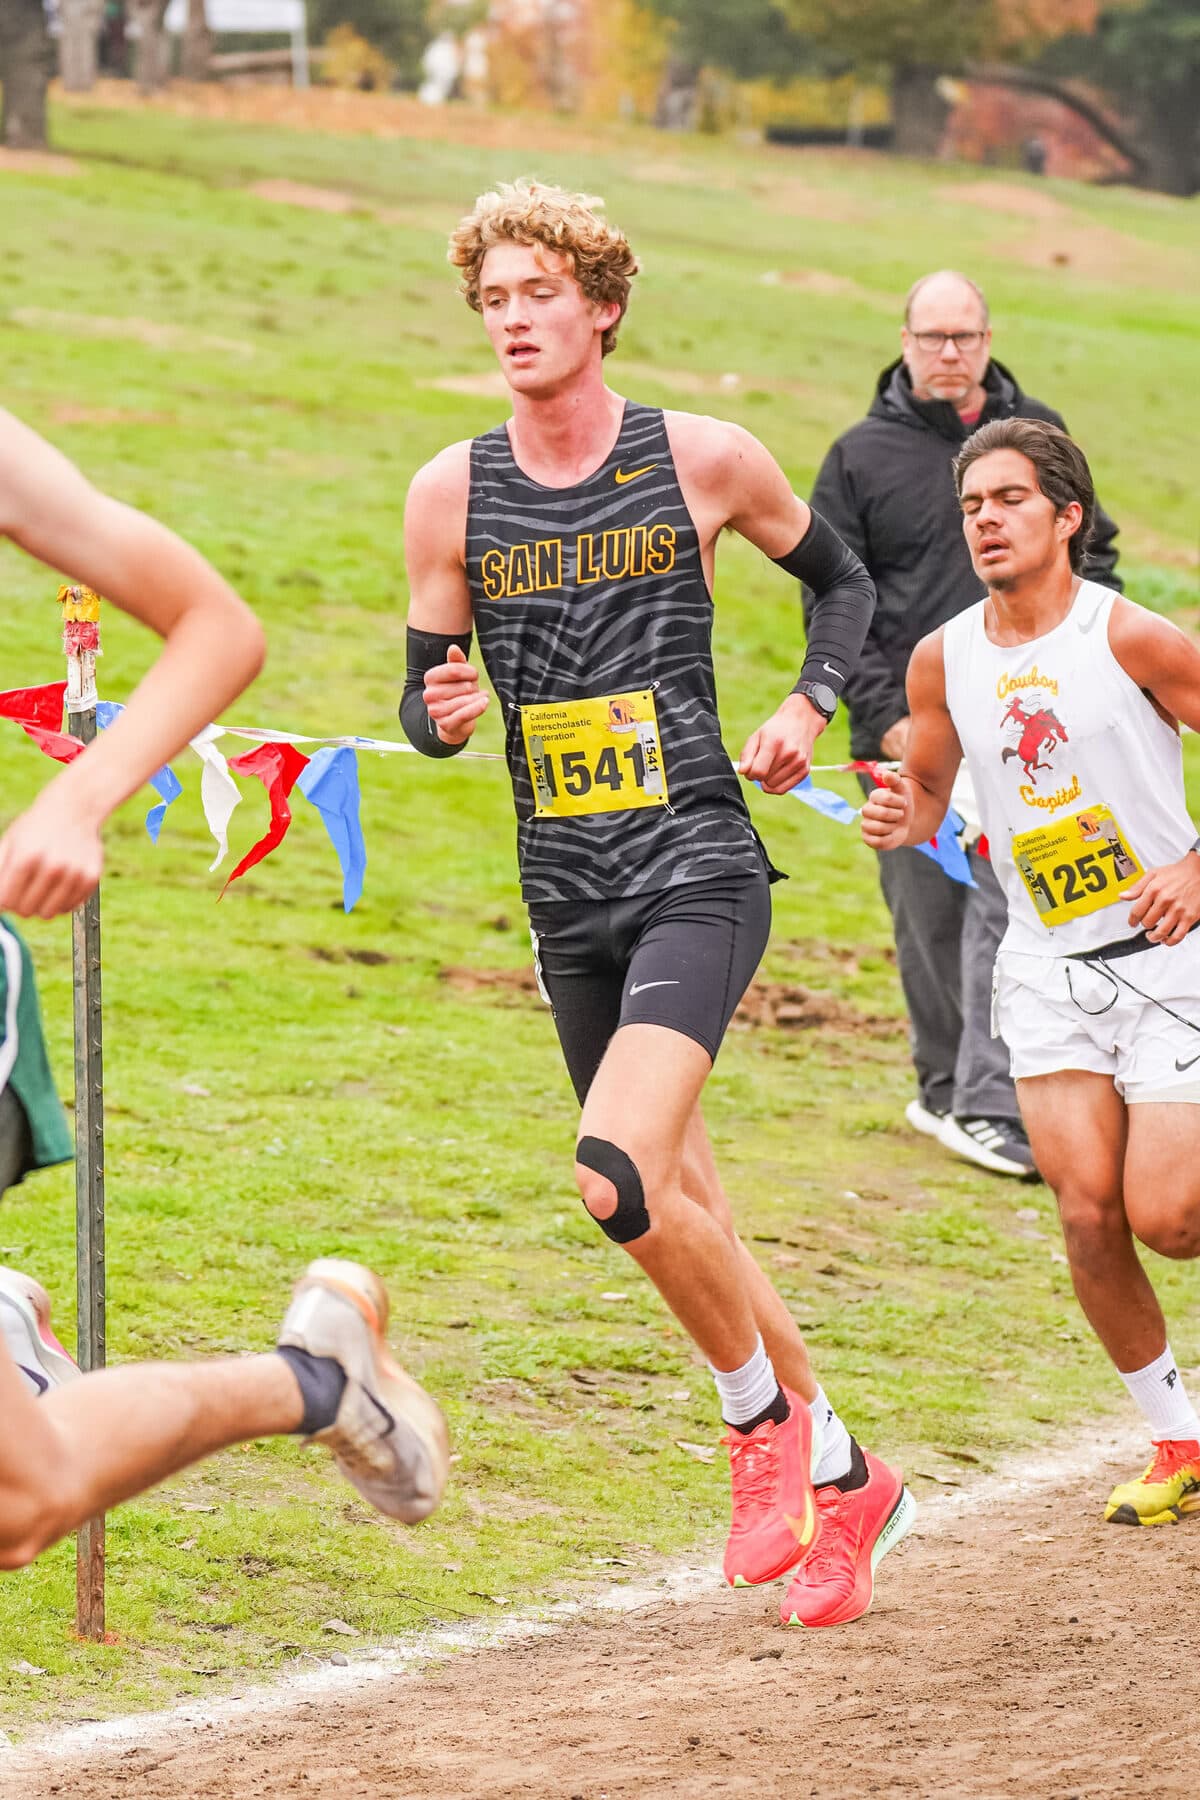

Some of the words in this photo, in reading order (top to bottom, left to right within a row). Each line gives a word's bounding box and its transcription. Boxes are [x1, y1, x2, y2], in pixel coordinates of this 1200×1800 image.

[481, 549, 562, 600] SAN
[577, 524, 676, 584] LUIS
[996, 664, 1059, 699] Cowboy
[530, 711, 567, 720] California
[531, 719, 592, 731] Interscholastic
[533, 731, 576, 742] deration
[543, 742, 646, 798] 1541
[645, 737, 659, 772] 1541
[1018, 773, 1082, 814] Capital
[1019, 835, 1069, 856] terscholastic
[1107, 837, 1128, 865] 127
[1022, 865, 1043, 895] 127
[1031, 842, 1124, 910] 1257
